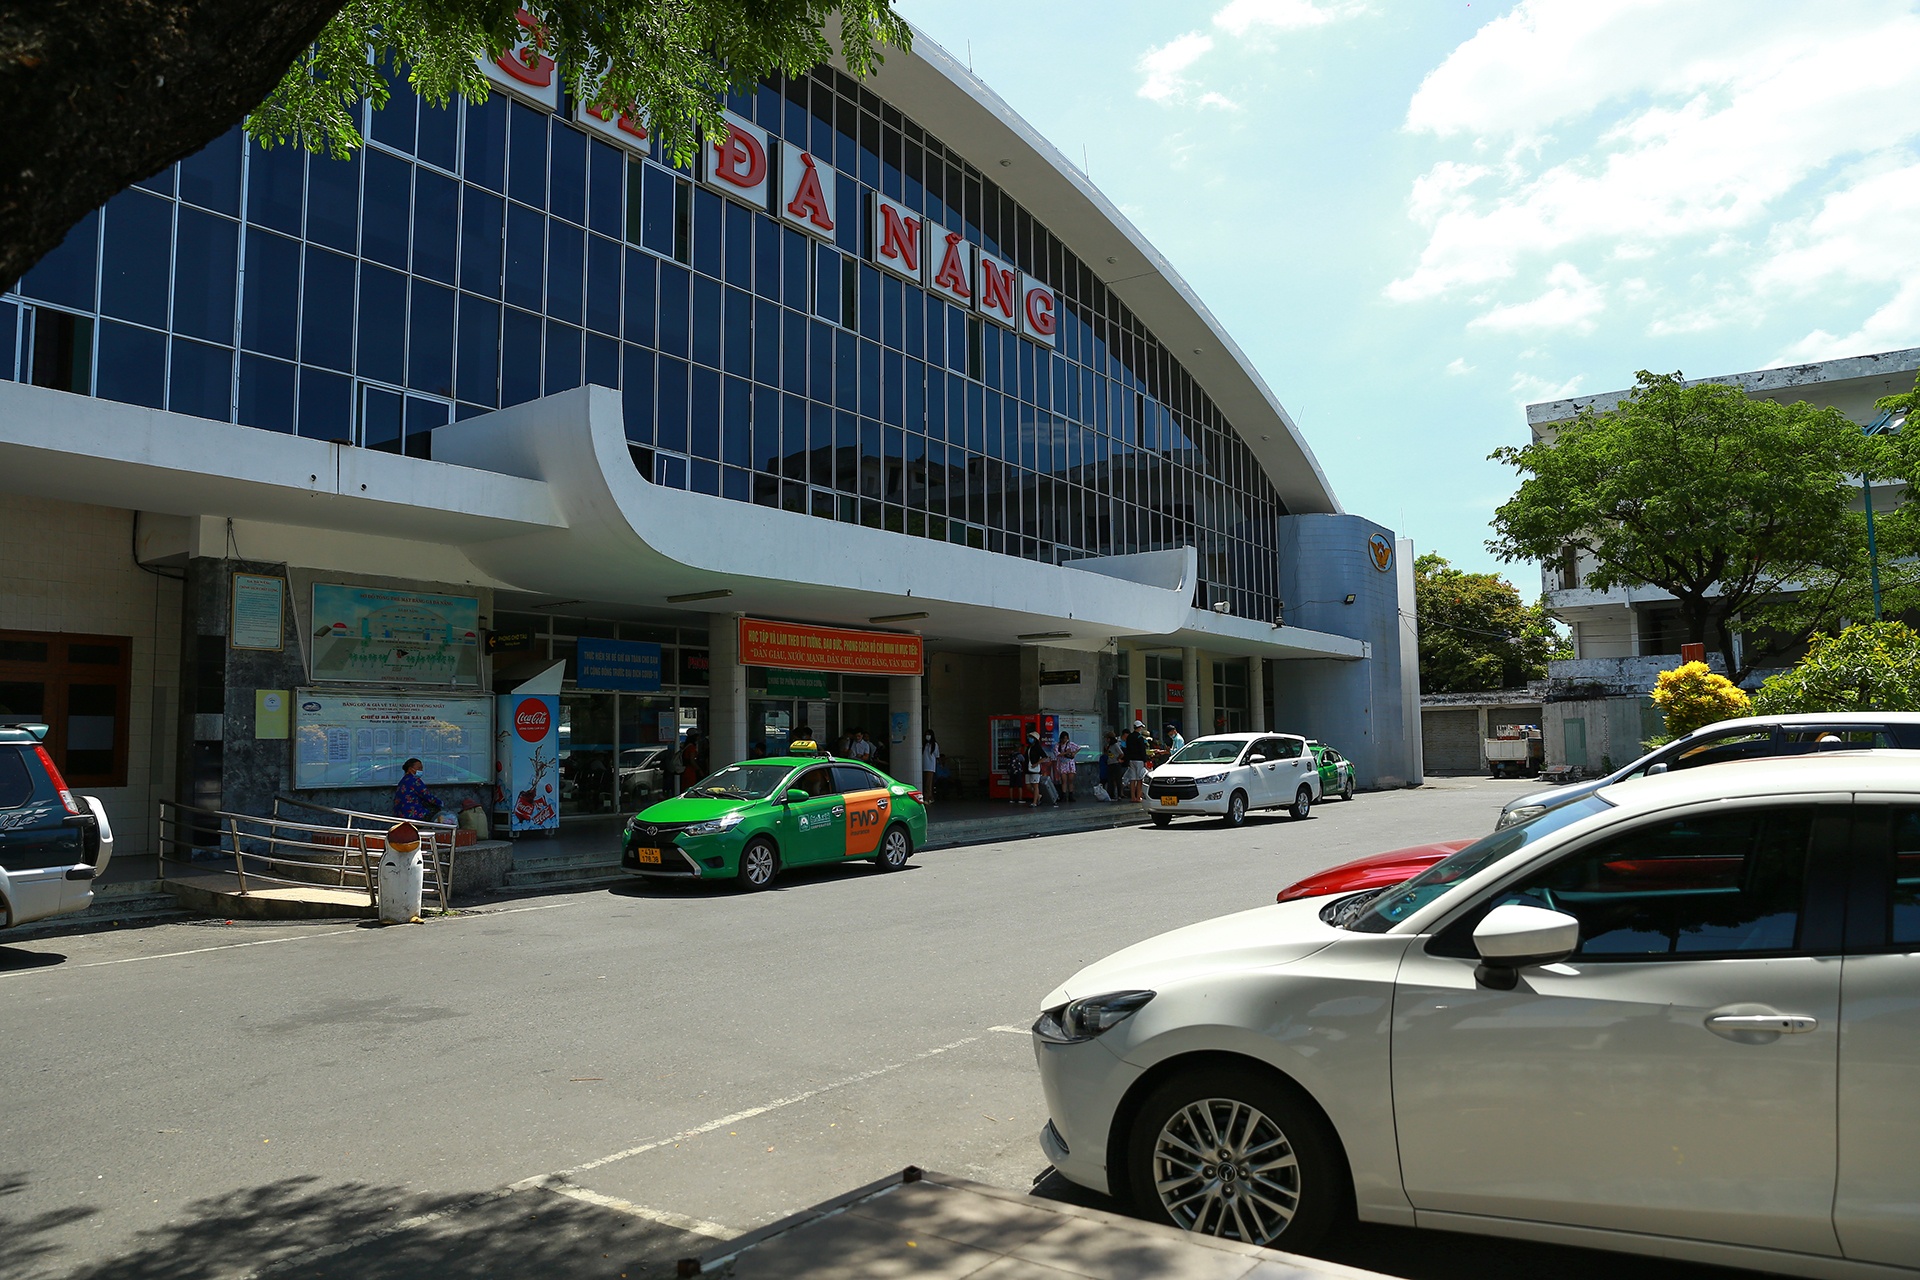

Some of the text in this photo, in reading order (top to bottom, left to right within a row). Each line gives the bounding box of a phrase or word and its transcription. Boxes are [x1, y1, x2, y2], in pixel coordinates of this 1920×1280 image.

[714, 122, 834, 231] ĐÀ
[748, 630, 758, 645] HỌC
[760, 629, 769, 646] TẬP
[770, 630, 776, 644] VÀ
[777, 631, 787, 645] LÀM
[788, 634, 799, 646] THEO
[844, 640, 858, 652] PHONG
[859, 639, 869, 652] CÁCH
[870, 640, 876, 652] HỒ
[884, 643, 894, 654] MINH
[788, 650, 805, 662] NƯỚC
[855, 655, 871, 666] CÔNG
[850, 809, 879, 828] FWD
